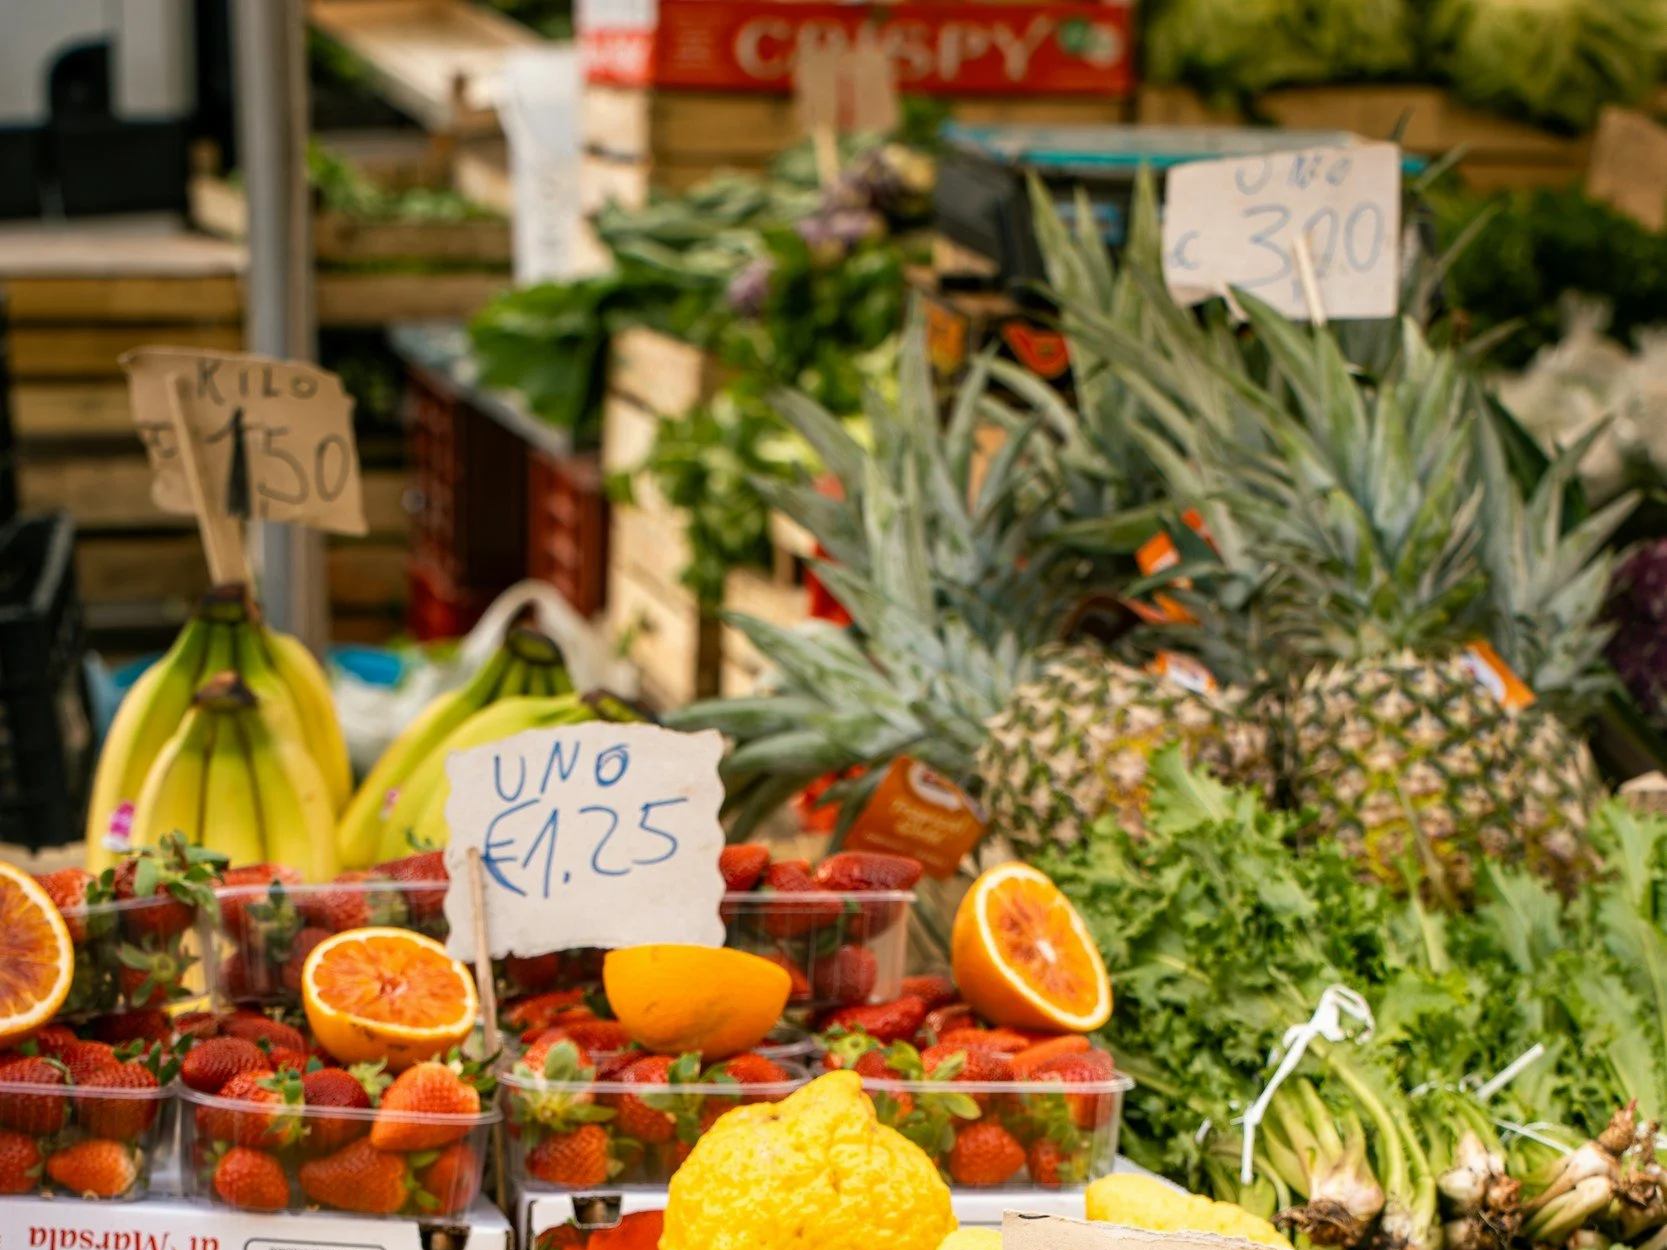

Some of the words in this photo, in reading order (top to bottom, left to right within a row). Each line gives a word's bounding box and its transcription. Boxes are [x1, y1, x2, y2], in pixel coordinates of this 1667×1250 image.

[1235, 153, 1351, 195] UNO
[197, 360, 320, 406] KILO
[494, 741, 630, 801] UNO
